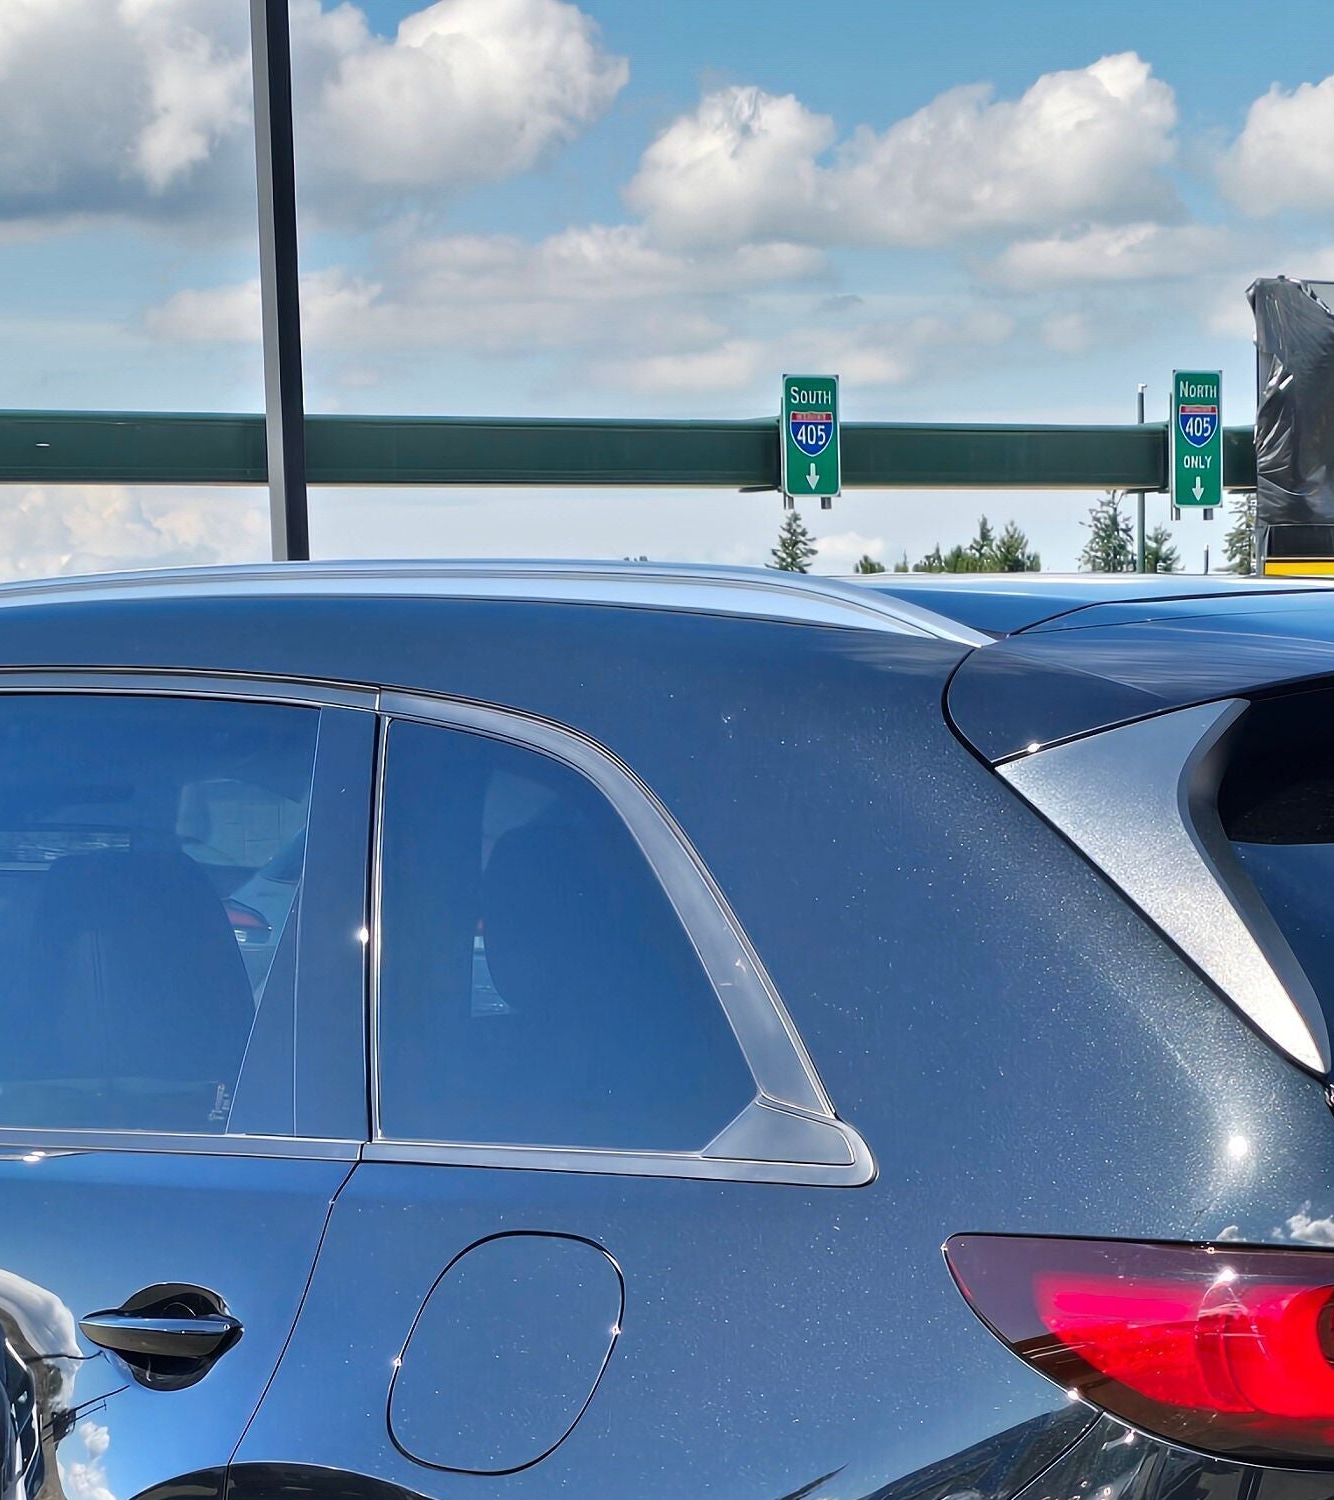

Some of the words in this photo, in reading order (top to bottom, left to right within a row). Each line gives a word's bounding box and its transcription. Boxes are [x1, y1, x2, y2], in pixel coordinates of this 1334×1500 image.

[790, 386, 831, 405] SOUTH
[1179, 380, 1217, 398] NORTH
[796, 424, 826, 445] 405
[1185, 417, 1212, 437] 405
[1183, 455, 1212, 469] ONLY
